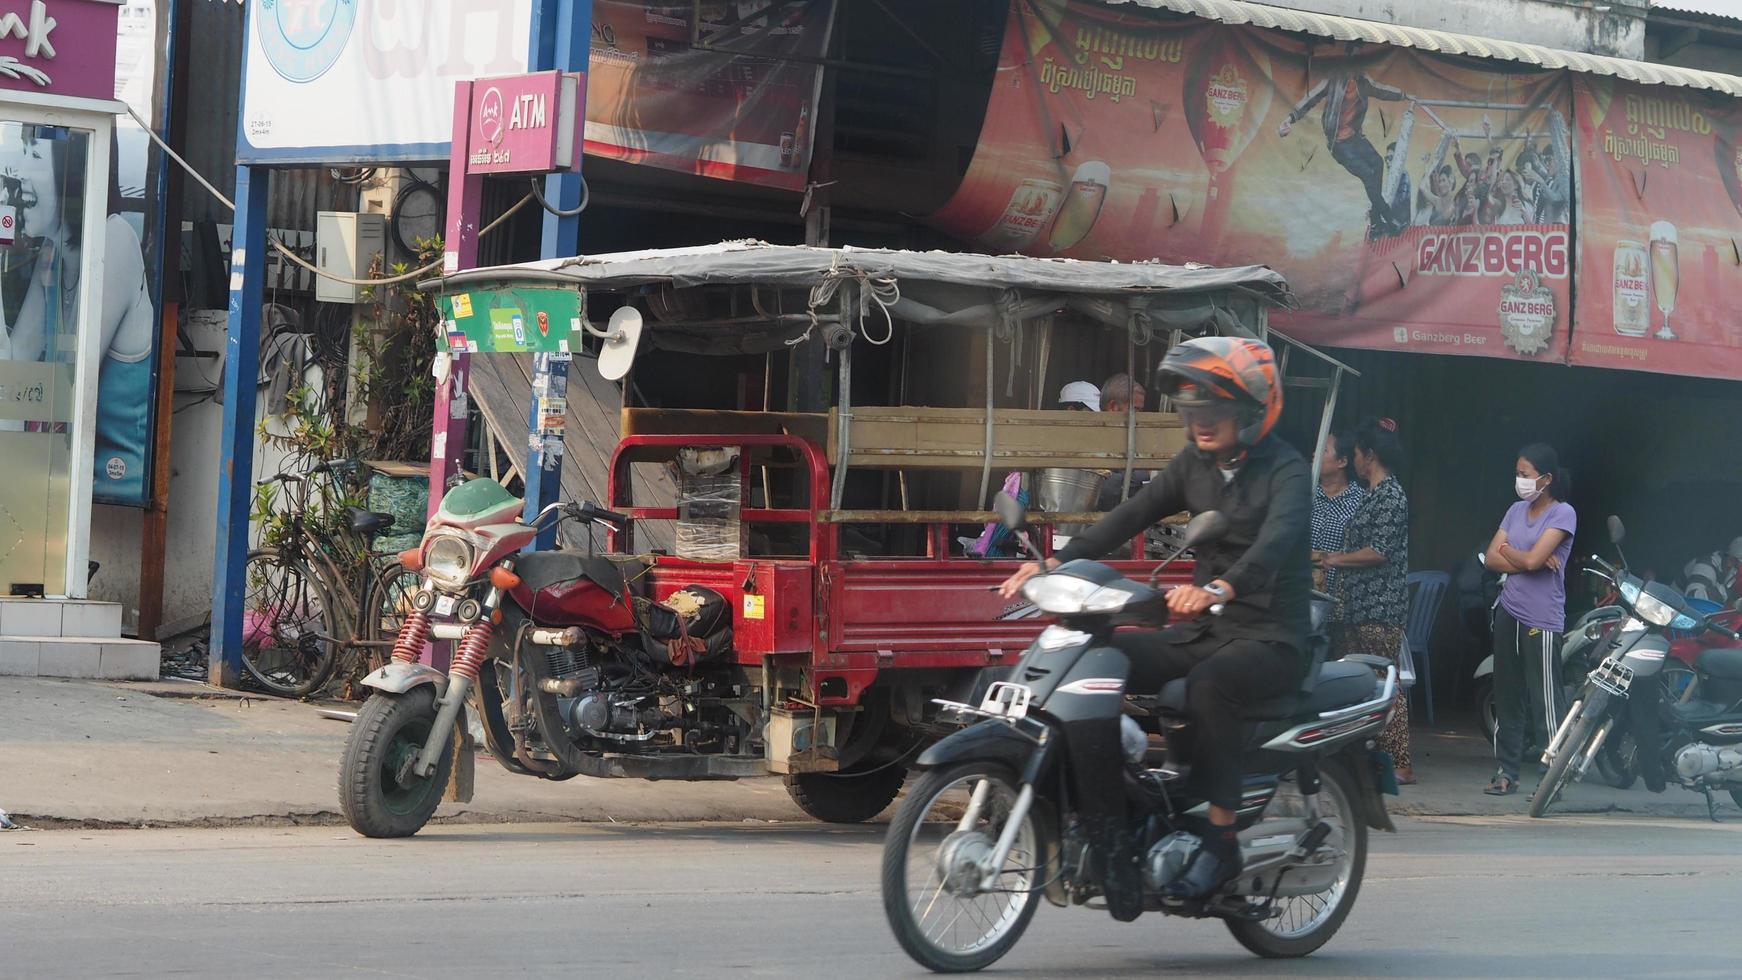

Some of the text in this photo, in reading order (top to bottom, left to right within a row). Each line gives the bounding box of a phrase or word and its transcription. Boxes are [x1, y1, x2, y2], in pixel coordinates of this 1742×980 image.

[509, 93, 545, 130] ATM
[1418, 234, 1567, 276] GANZBERG
[1501, 301, 1553, 316] GANZBERG
[1412, 331, 1487, 345] Ganzberg Beer
